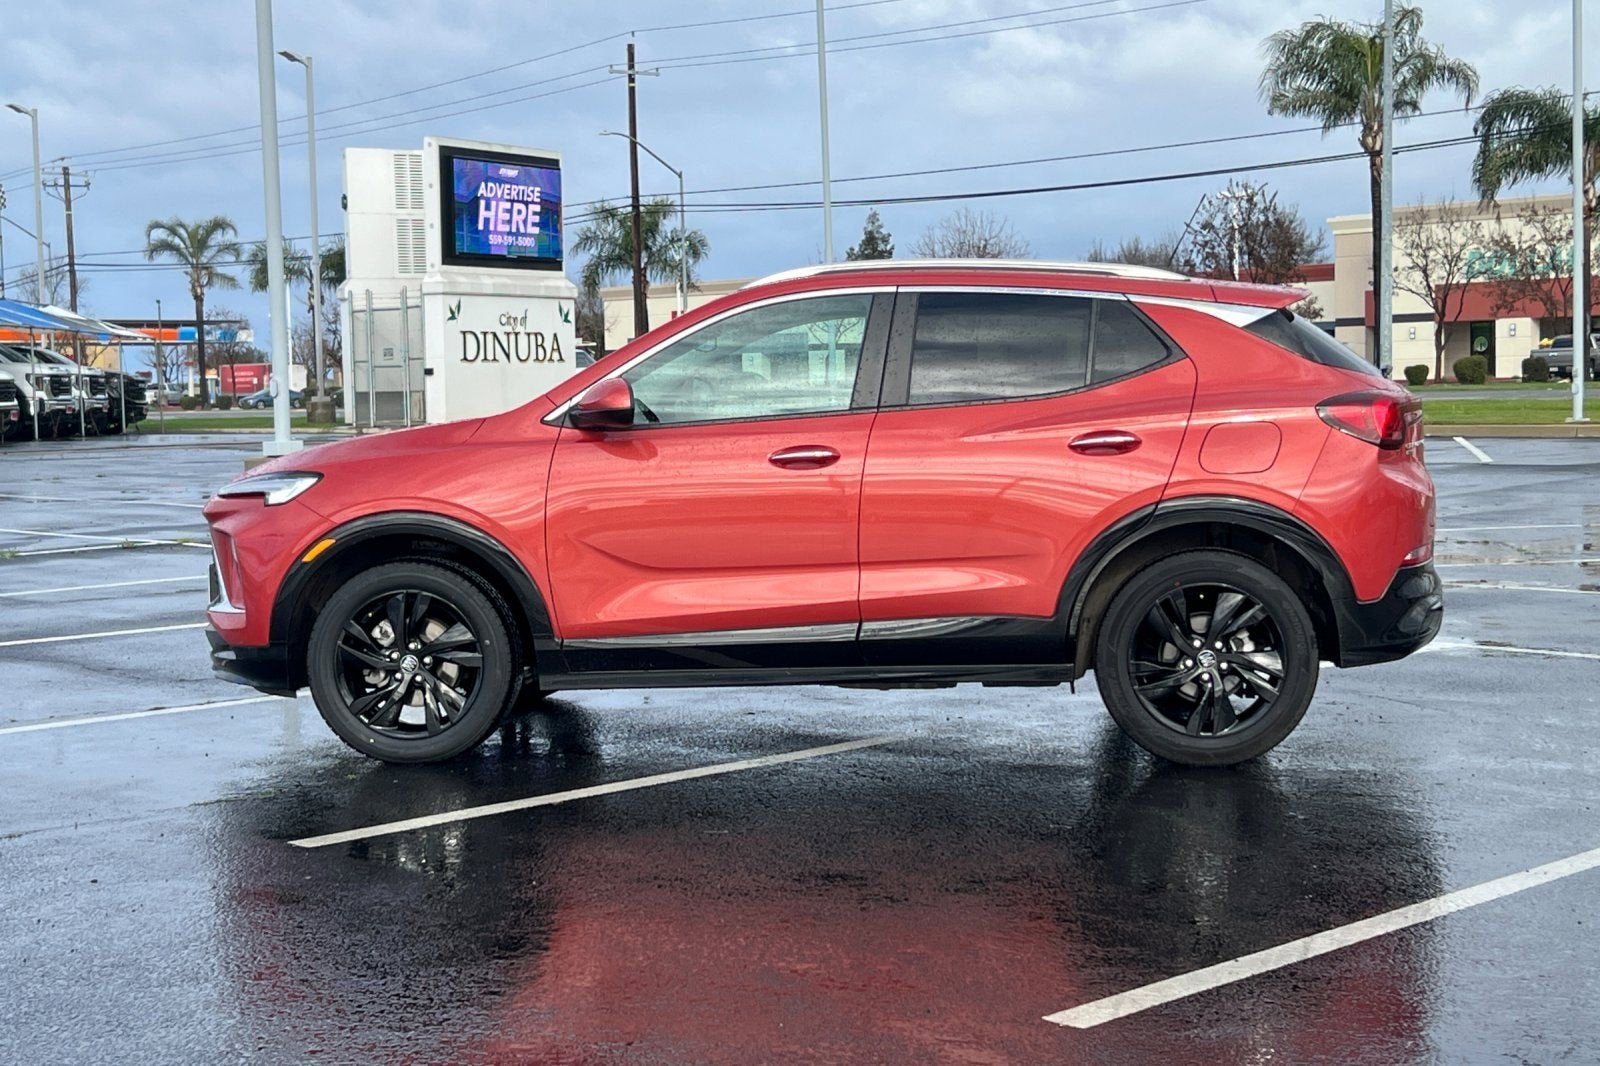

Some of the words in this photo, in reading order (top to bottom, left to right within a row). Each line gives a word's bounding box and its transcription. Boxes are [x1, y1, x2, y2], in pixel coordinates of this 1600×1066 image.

[478, 181, 541, 202] ADVERTISE
[478, 199, 541, 234] HERE
[488, 234, 535, 247] 559-591-5000
[499, 311, 518, 331] City
[520, 308, 528, 330] of
[460, 330, 565, 363] DINUBA
